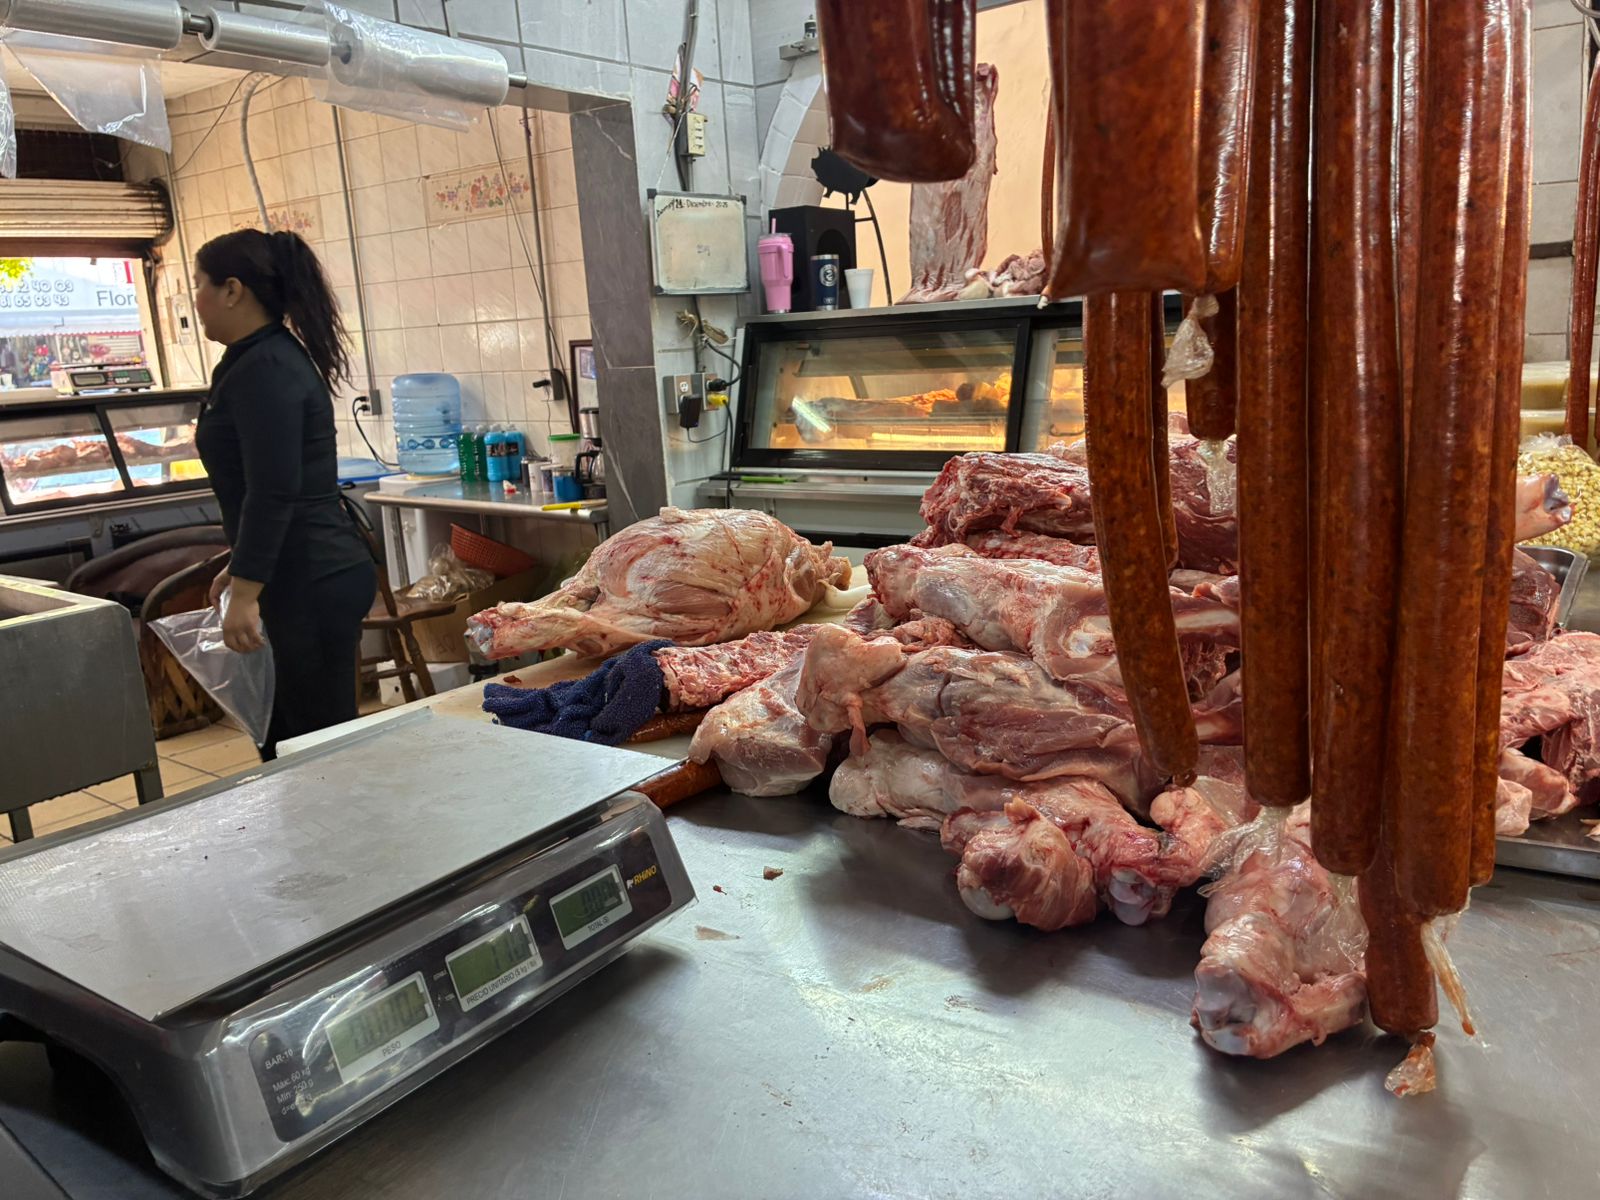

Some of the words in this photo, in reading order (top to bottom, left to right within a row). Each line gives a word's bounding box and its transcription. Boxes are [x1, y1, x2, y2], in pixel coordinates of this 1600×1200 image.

[96, 289, 138, 307] Flor
[634, 865, 657, 884] RHINO
[466, 987, 489, 1005] PRECIO
[488, 972, 515, 992] UNITARIO
[381, 1040, 402, 1057] PESO
